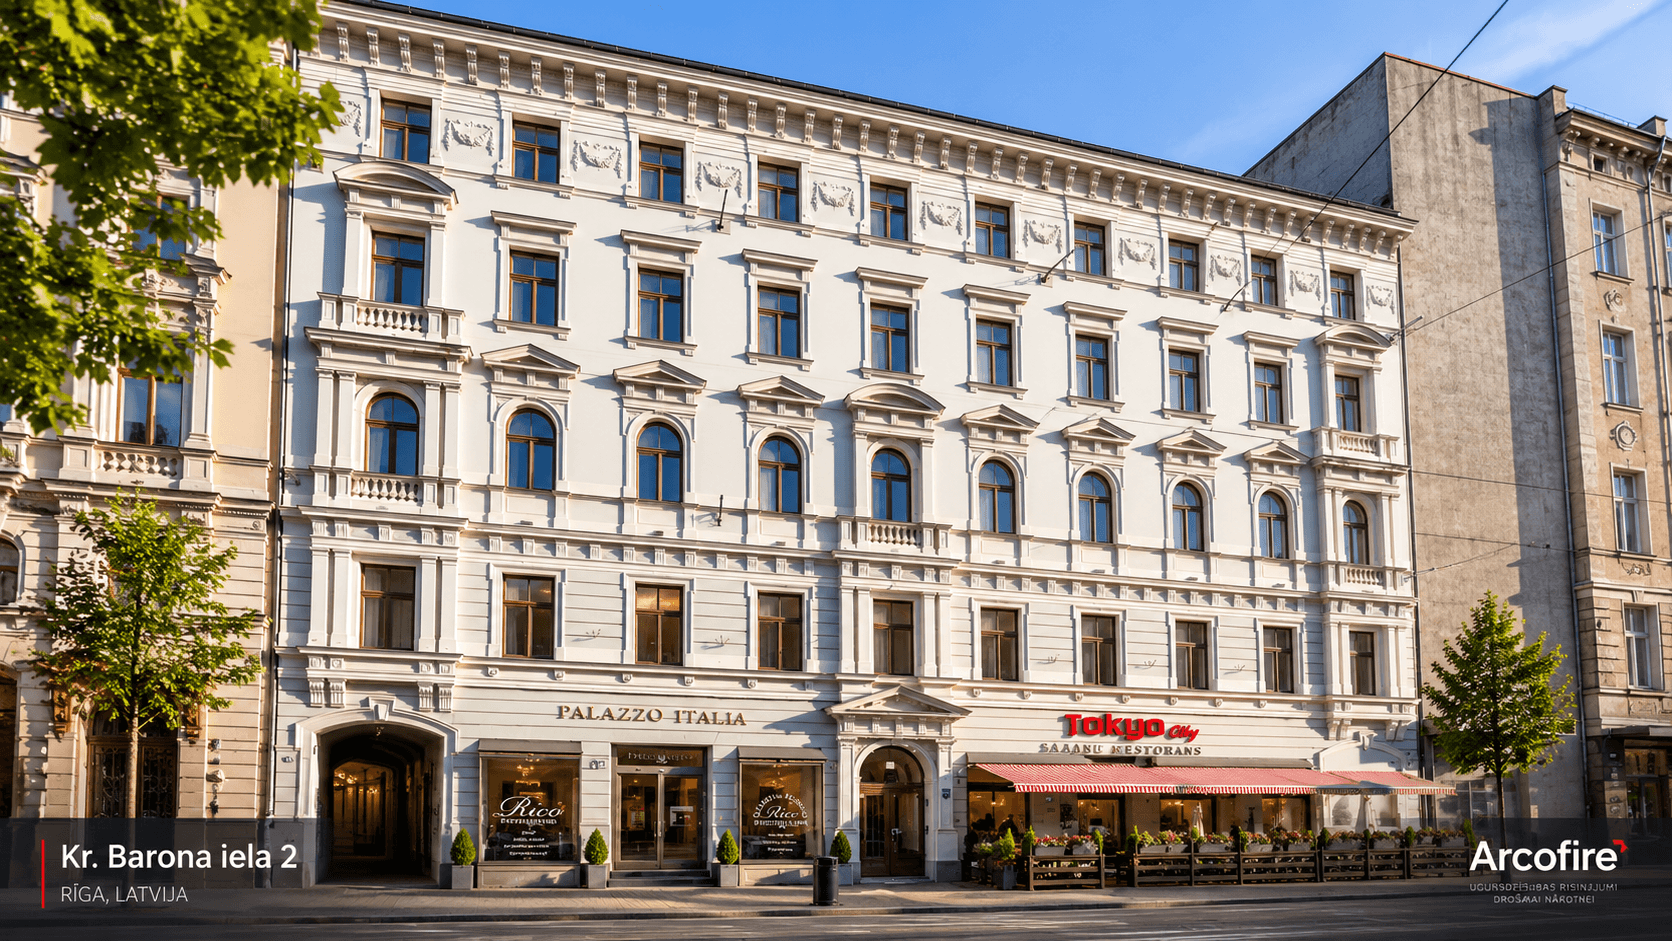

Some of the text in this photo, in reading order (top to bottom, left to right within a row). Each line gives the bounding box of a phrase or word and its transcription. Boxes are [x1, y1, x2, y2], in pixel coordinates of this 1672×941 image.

[556, 705, 747, 726] PALAZZO ITALIA
[1064, 712, 1165, 741] Tokyo
[492, 796, 564, 818] Rico
